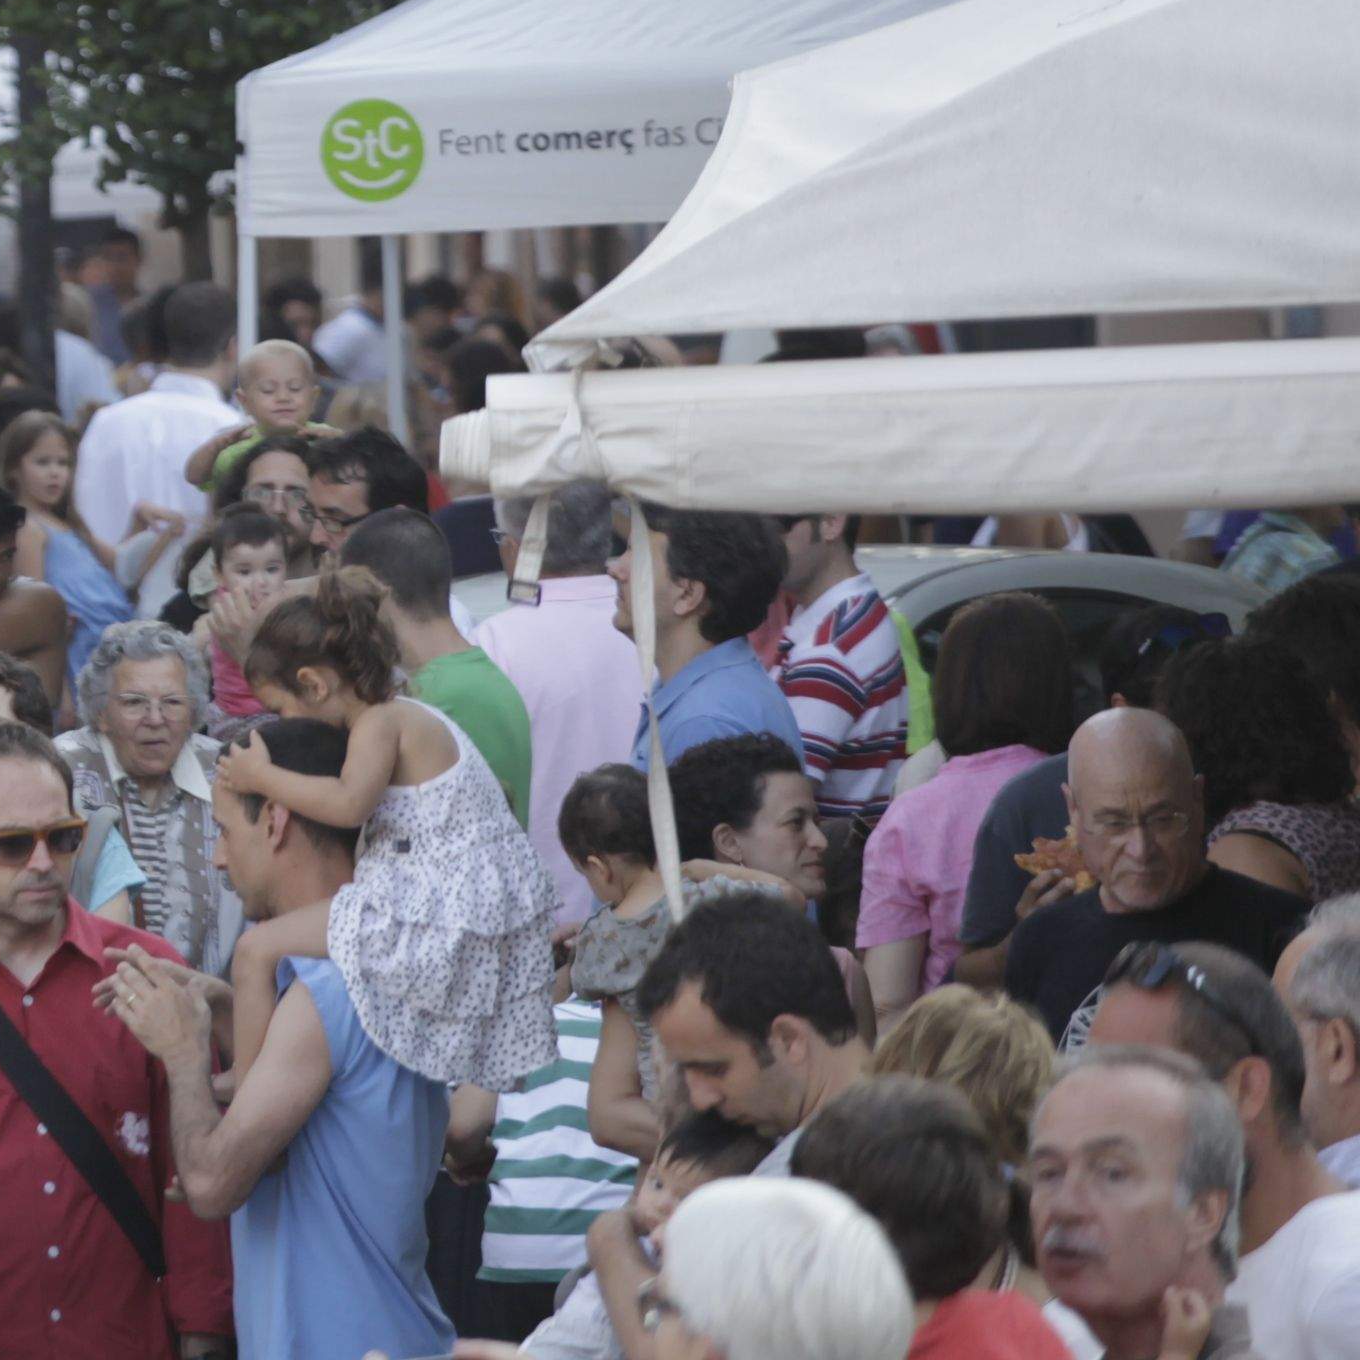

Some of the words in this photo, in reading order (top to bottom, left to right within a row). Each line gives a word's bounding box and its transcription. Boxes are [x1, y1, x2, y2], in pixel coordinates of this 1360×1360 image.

[331, 115, 410, 168] StC
[438, 128, 507, 156] Fent
[515, 126, 634, 155] comerç
[642, 119, 685, 148] fas
